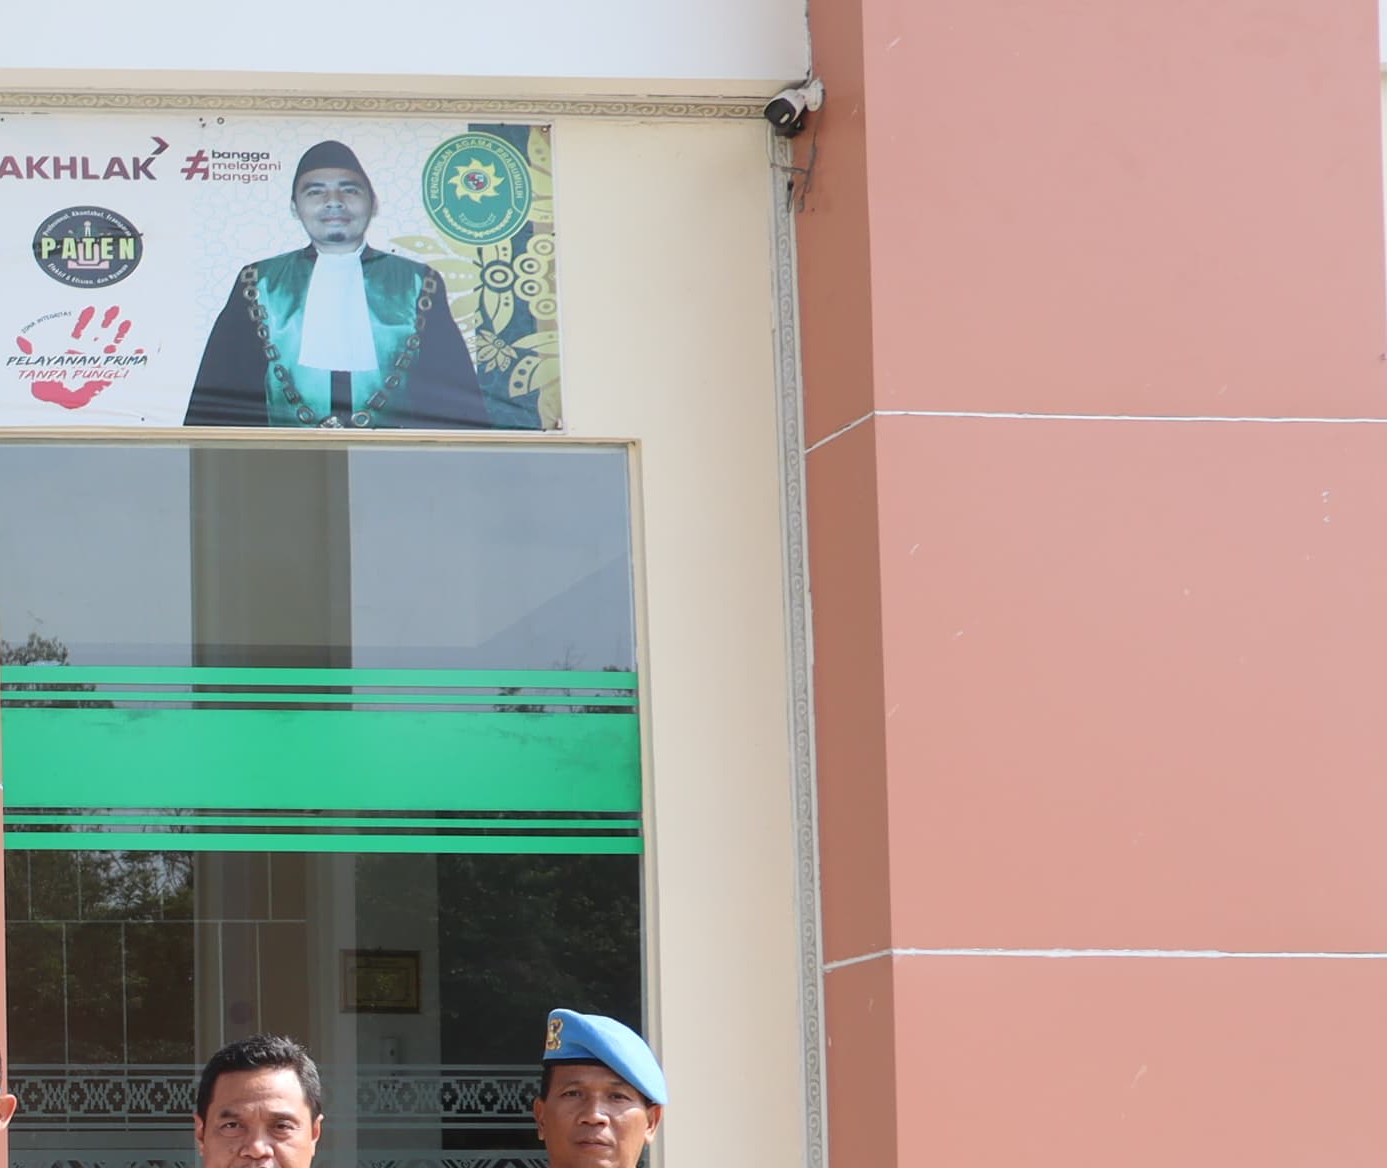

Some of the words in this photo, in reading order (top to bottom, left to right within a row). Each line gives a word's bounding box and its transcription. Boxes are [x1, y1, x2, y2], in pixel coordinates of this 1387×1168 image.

[211, 149, 270, 162] bangga
[211, 161, 282, 172] melayani
[212, 172, 269, 183] bangsa
[41, 237, 135, 260] PATEN
[6, 355, 101, 367] PELAYANAN
[103, 355, 148, 367] PRIMA
[18, 369, 68, 380] TANPA
[72, 369, 130, 380] PUNGLI
